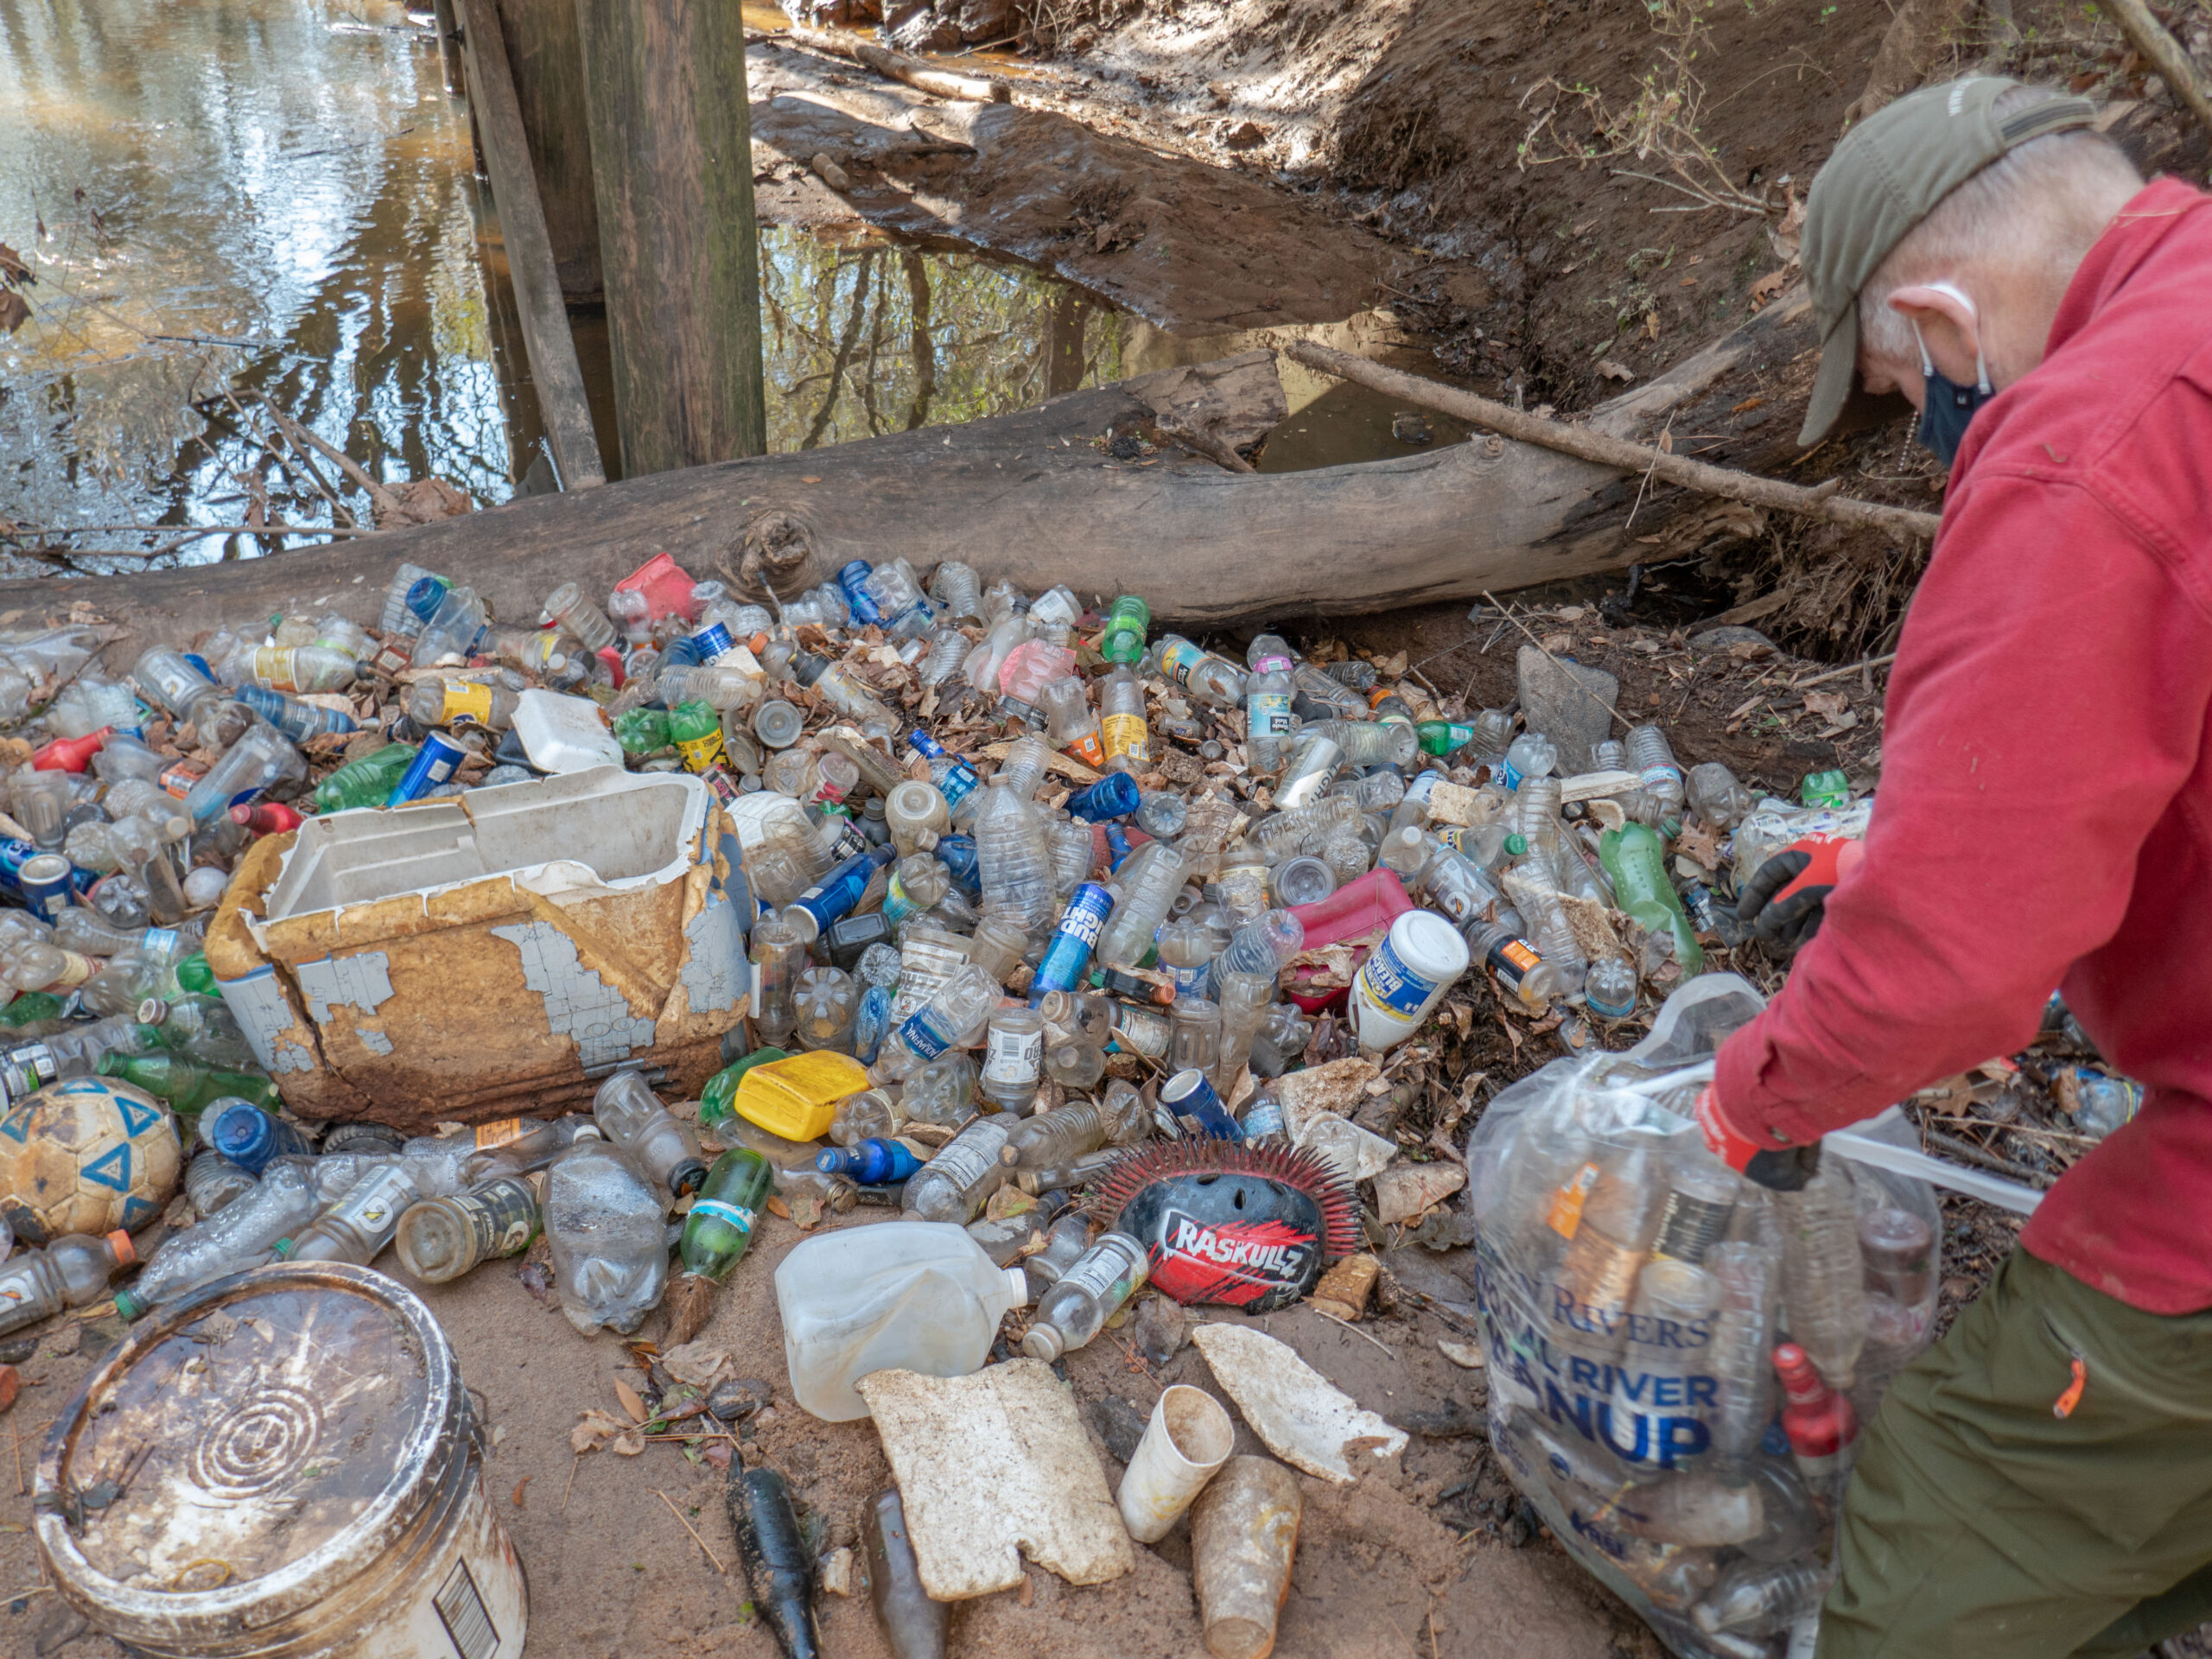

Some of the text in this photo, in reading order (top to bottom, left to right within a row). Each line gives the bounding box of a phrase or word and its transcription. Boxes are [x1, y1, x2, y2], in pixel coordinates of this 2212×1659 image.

[1311, 763, 1338, 802] LIGH
[1060, 918, 1098, 950] BUD
[906, 1022, 941, 1058] AQUAFINA
[1176, 1218, 1303, 1279] RASKULLZ
[1553, 1285, 1710, 1349] RIVERS
[1570, 1354, 1719, 1408] RIVER
